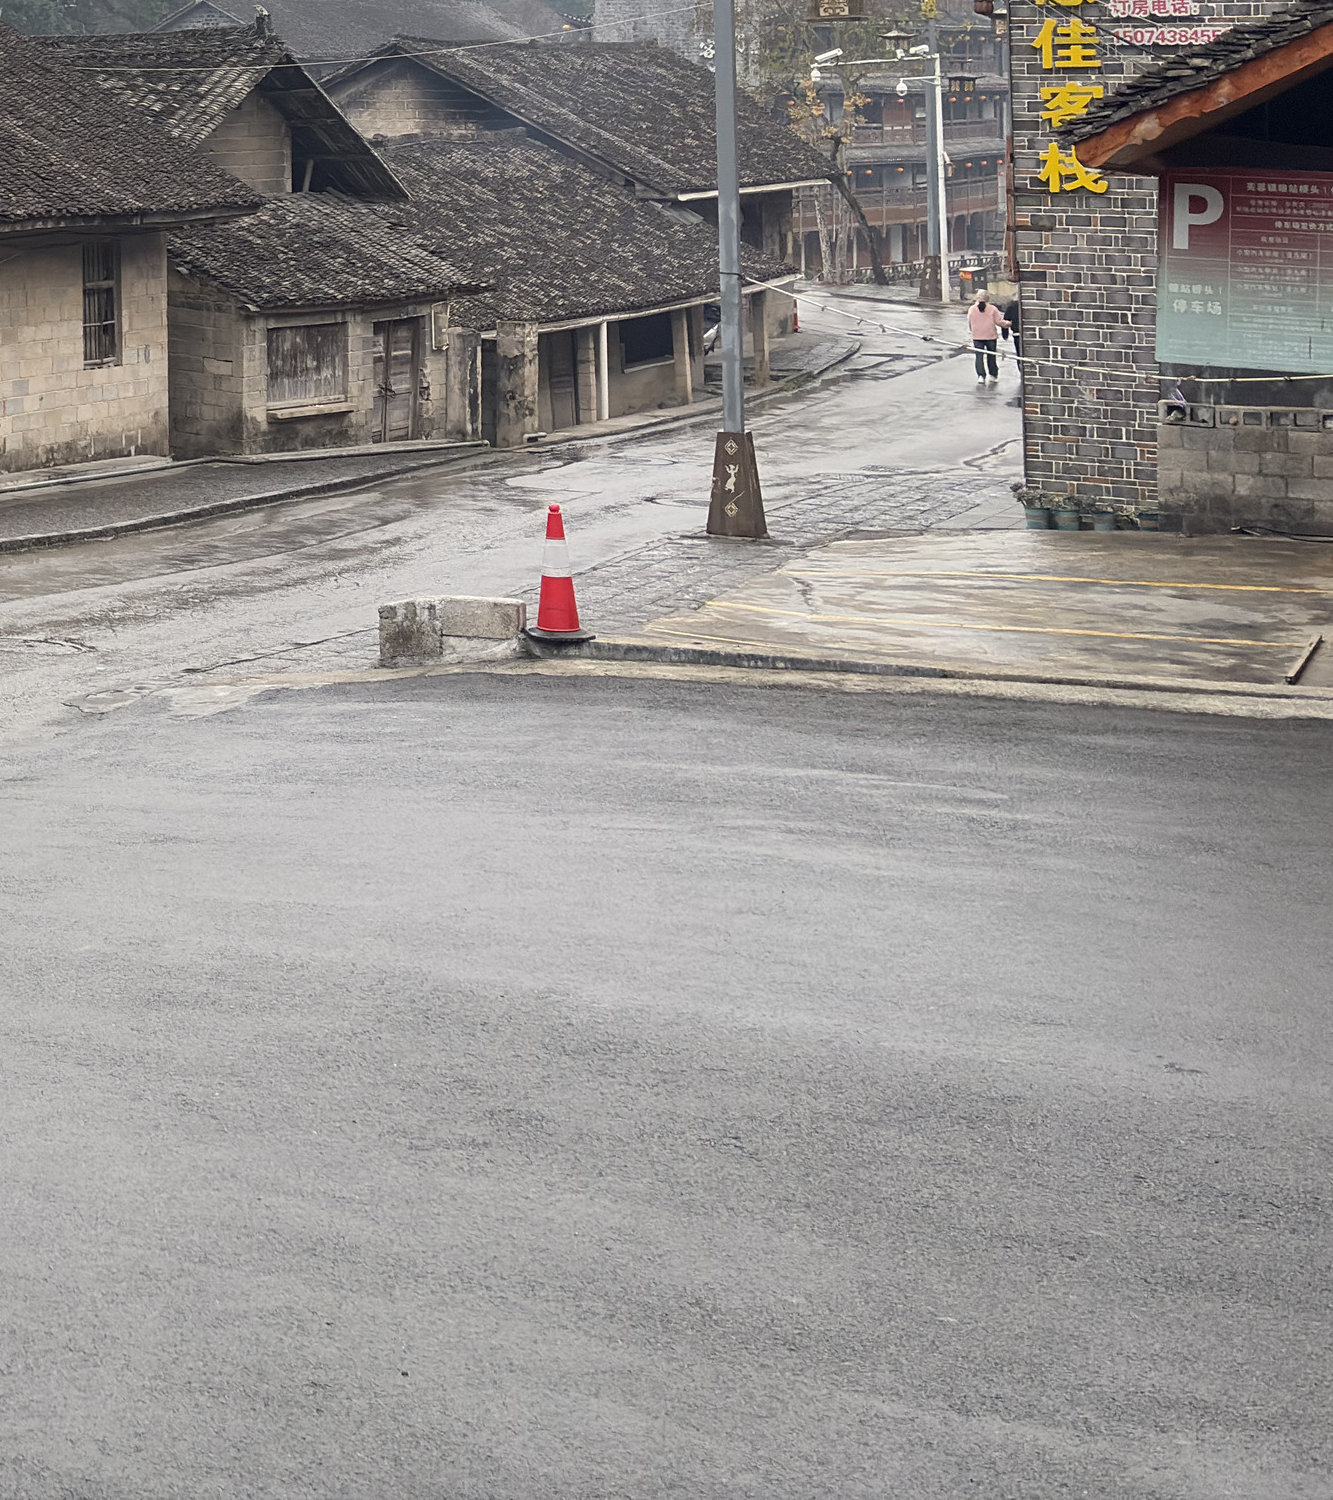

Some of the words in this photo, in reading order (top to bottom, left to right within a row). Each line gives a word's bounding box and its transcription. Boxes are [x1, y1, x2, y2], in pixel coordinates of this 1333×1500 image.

[1113, 27, 1233, 46] 1507438455
[1173, 182, 1224, 250] P
[1172, 298, 1222, 315] 停车场
